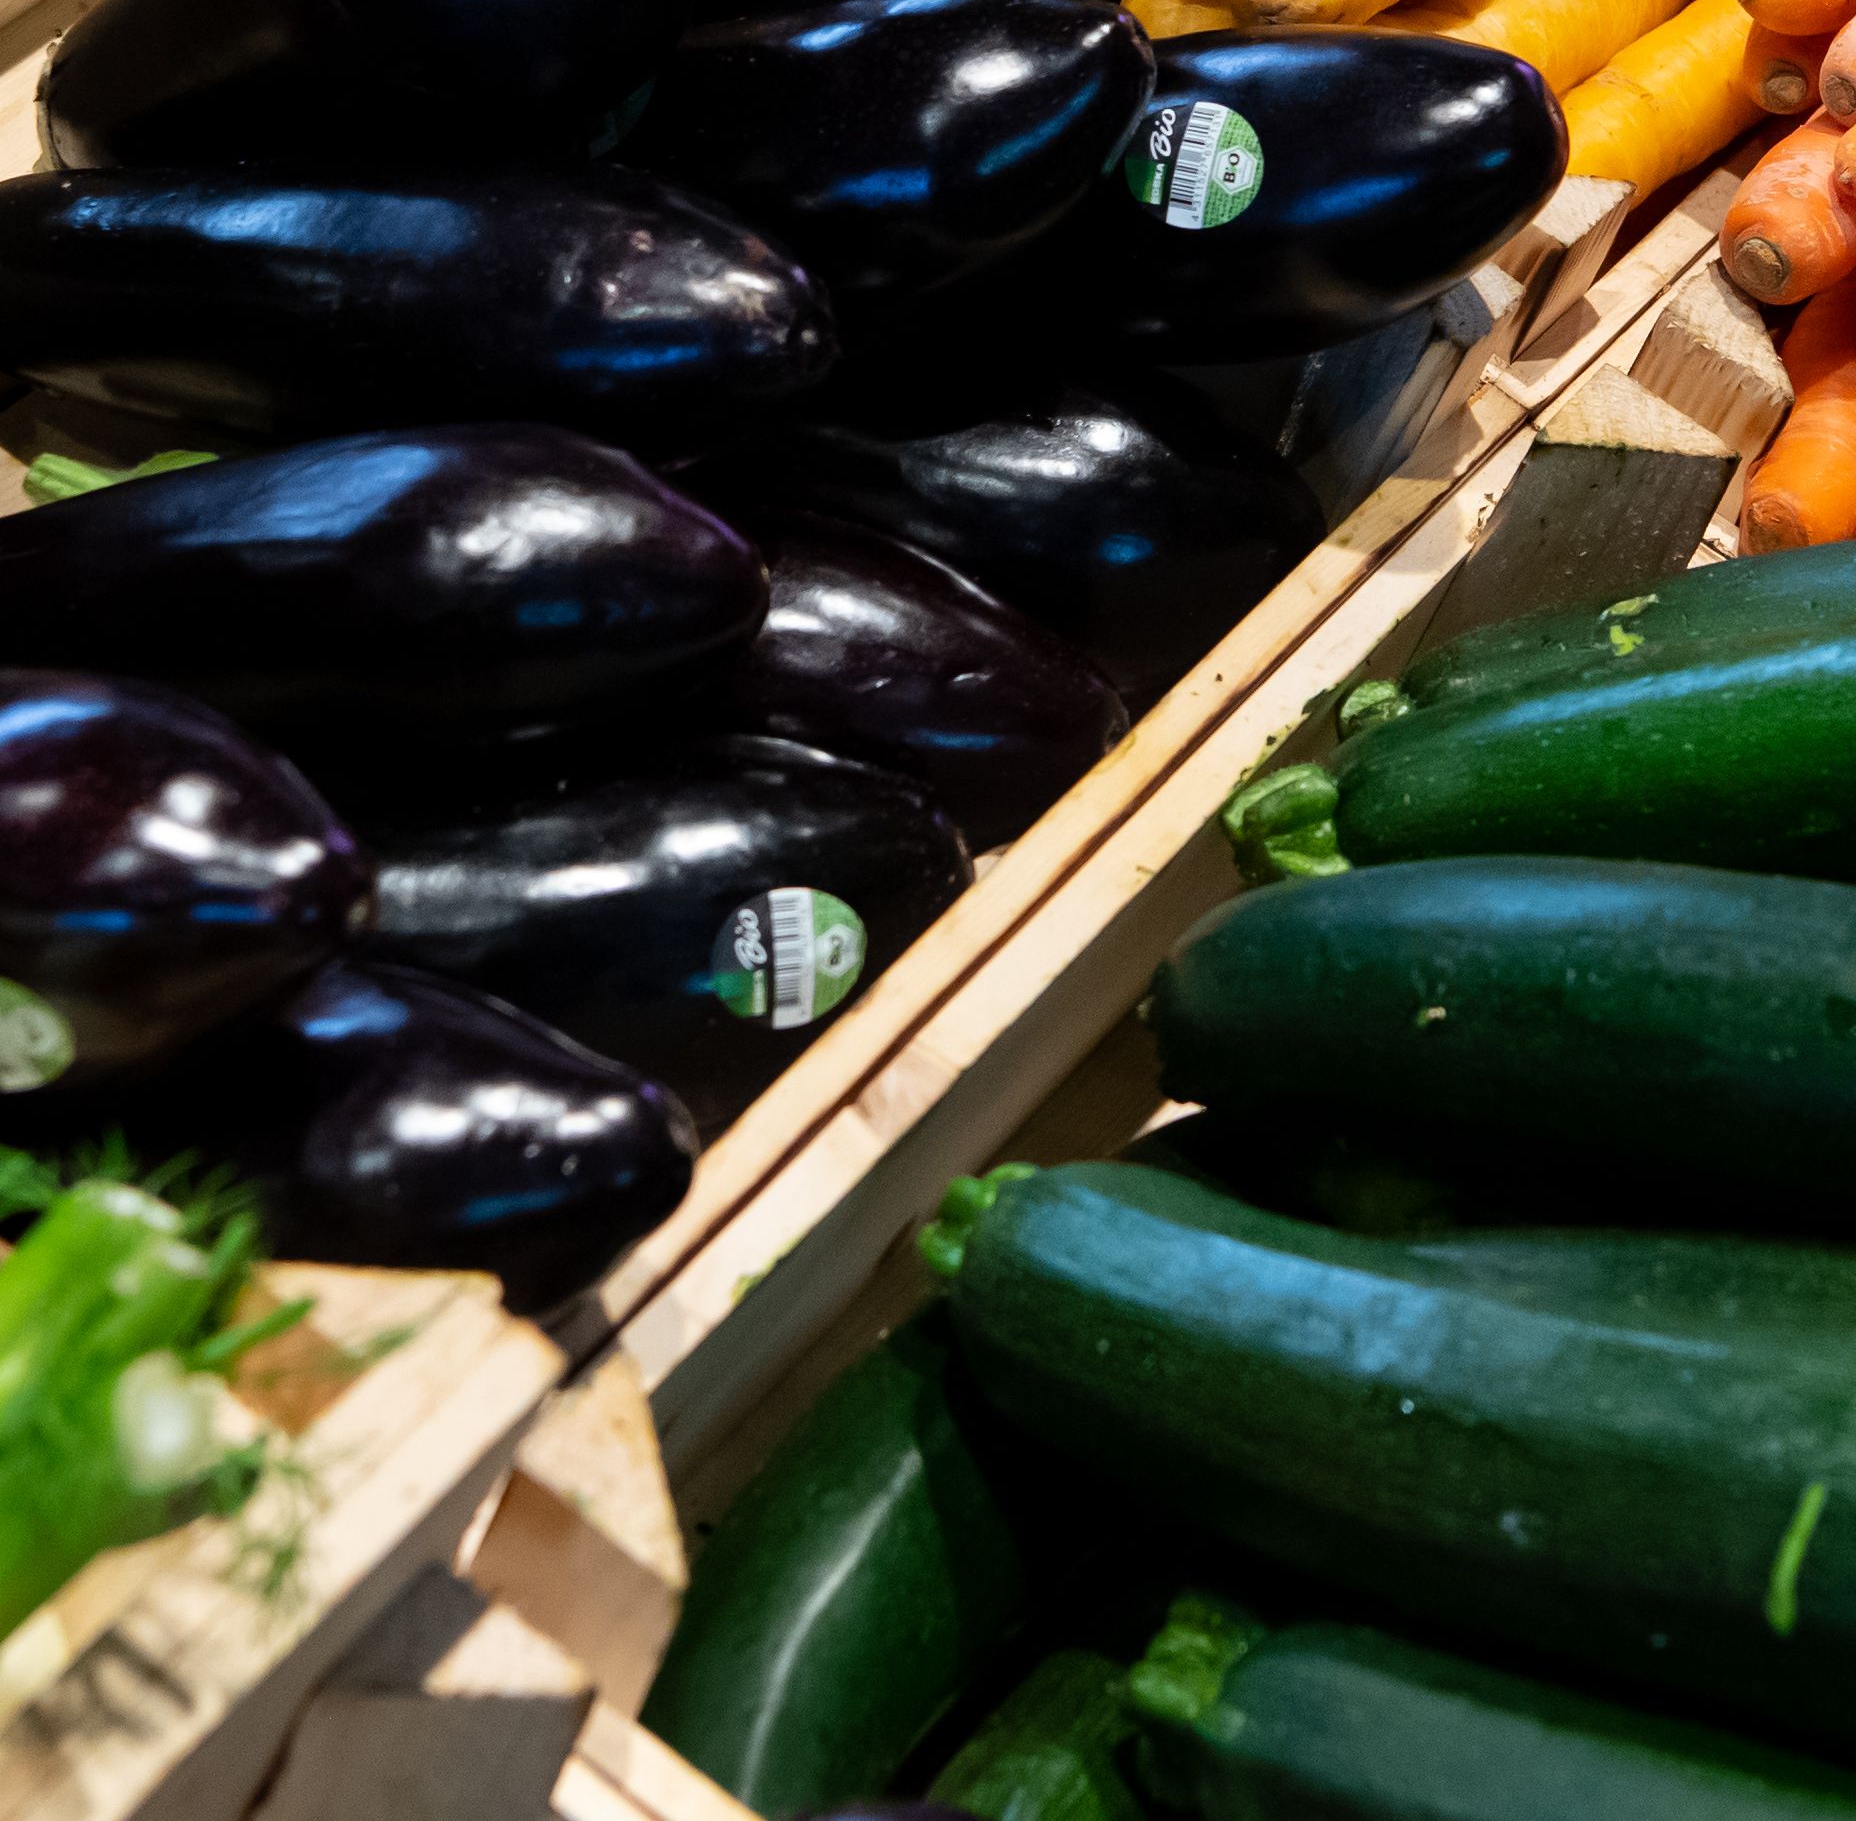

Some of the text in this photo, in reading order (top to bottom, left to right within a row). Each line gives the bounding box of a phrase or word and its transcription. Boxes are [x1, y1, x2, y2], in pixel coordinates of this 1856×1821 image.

[1149, 108, 1176, 162] Bio
[1223, 152, 1241, 183] BIO
[735, 908, 768, 970] Bio
